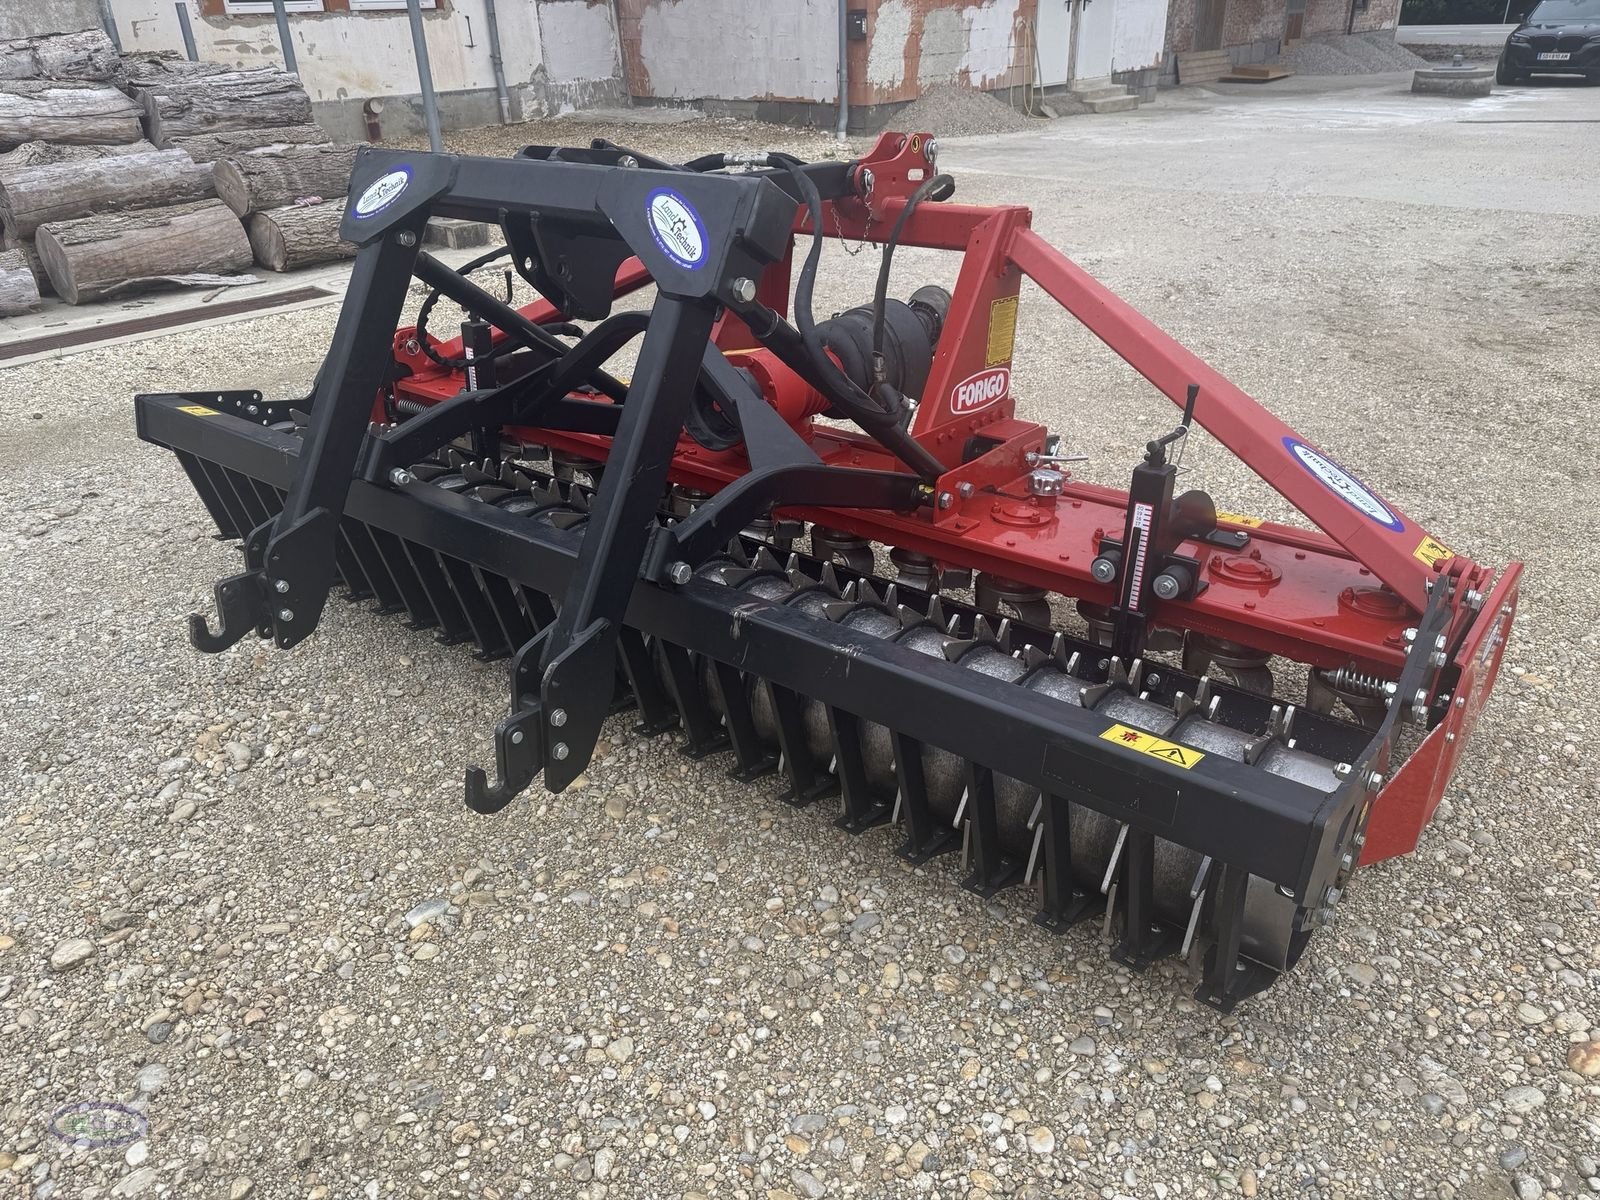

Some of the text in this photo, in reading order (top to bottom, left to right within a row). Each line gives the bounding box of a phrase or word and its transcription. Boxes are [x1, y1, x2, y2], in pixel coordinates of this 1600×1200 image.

[382, 177, 404, 196] Technik
[661, 200, 679, 222] Land
[674, 227, 697, 259] Technik
[957, 373, 1004, 410] FORIGO
[1302, 450, 1345, 484] Technik
[1347, 490, 1378, 514] Land
